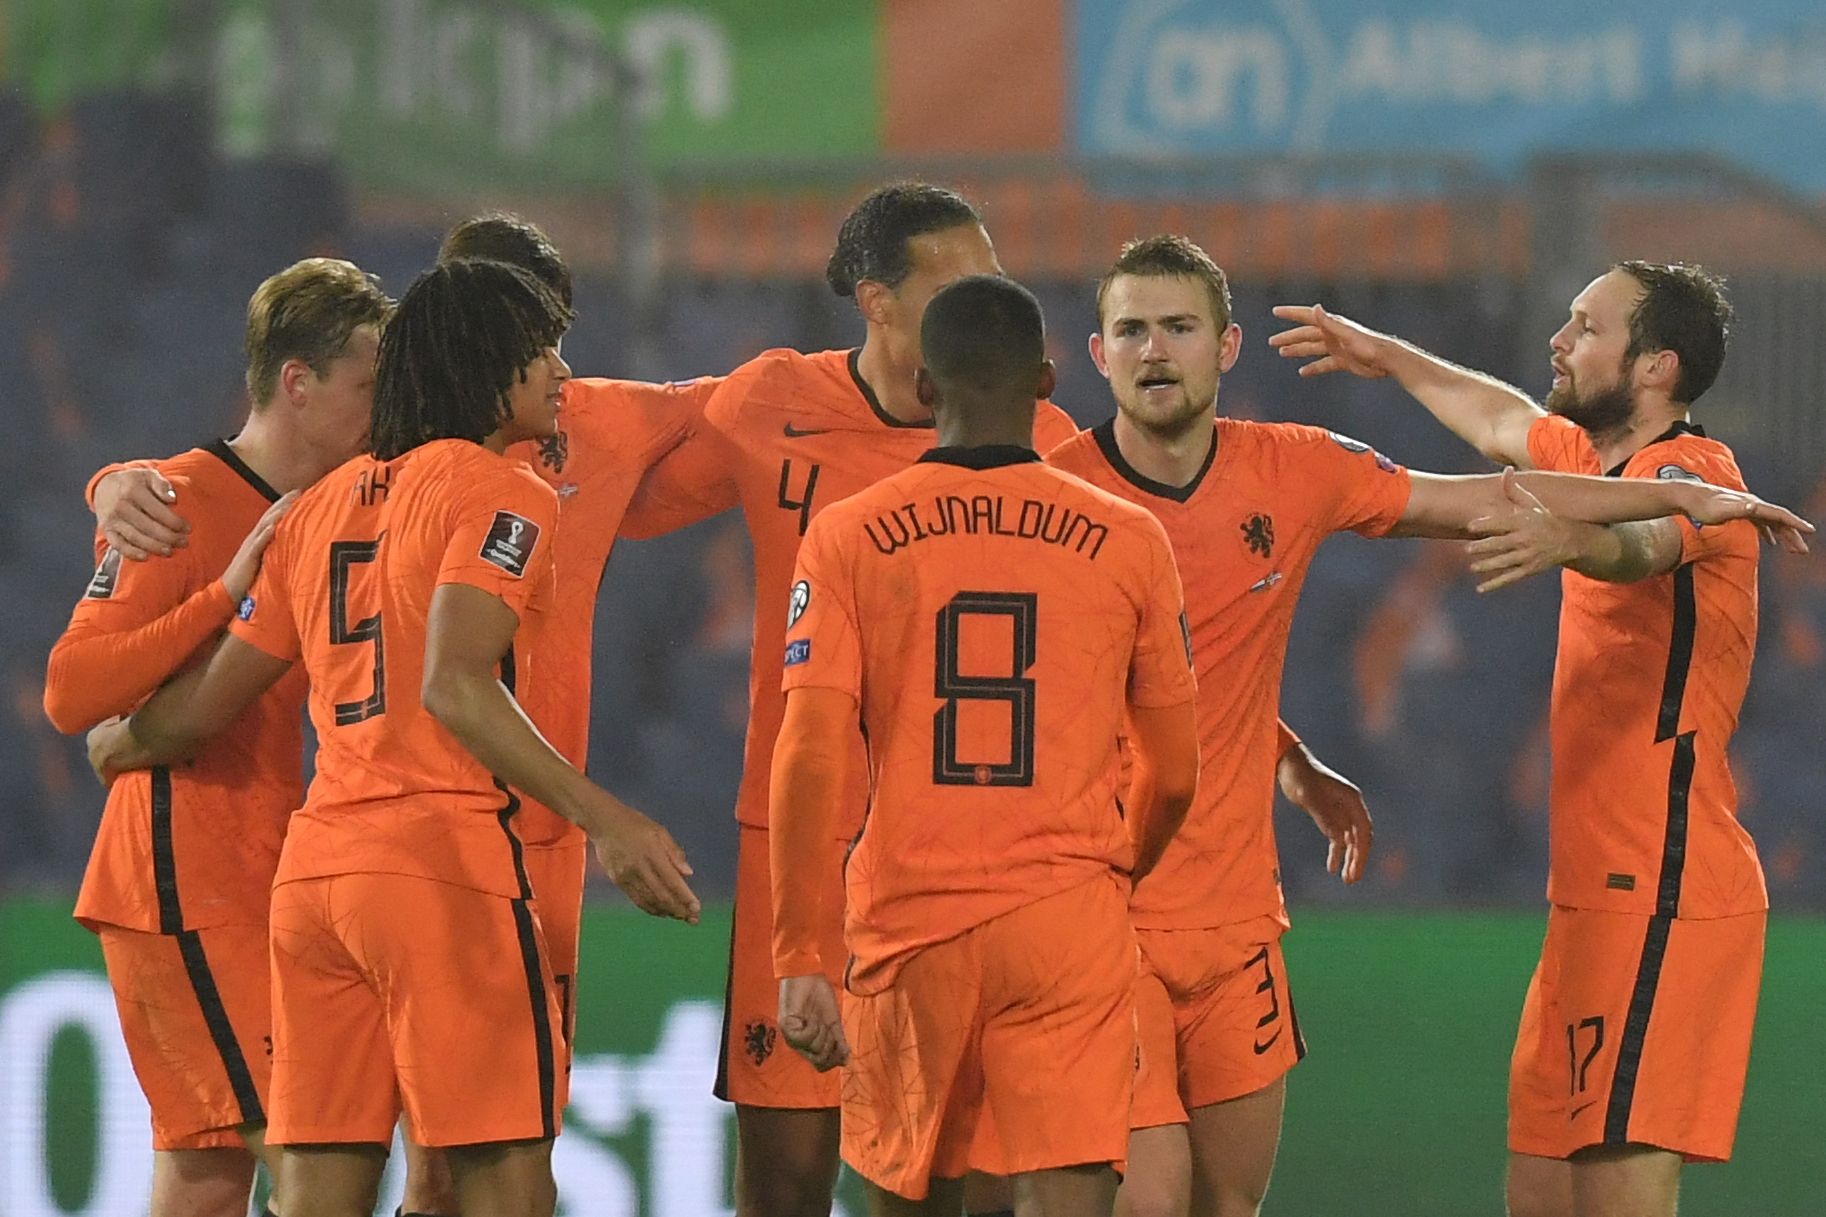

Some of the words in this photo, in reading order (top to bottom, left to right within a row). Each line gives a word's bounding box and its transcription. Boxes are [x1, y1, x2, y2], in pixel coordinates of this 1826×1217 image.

[349, 465, 391, 507] AK
[778, 458, 820, 537] 4
[863, 495, 1109, 561] WIJNALDUM
[328, 528, 388, 727] 5
[932, 590, 1038, 787] 8
[1242, 945, 1280, 1030] 3
[1566, 1015, 1605, 1098] 17
